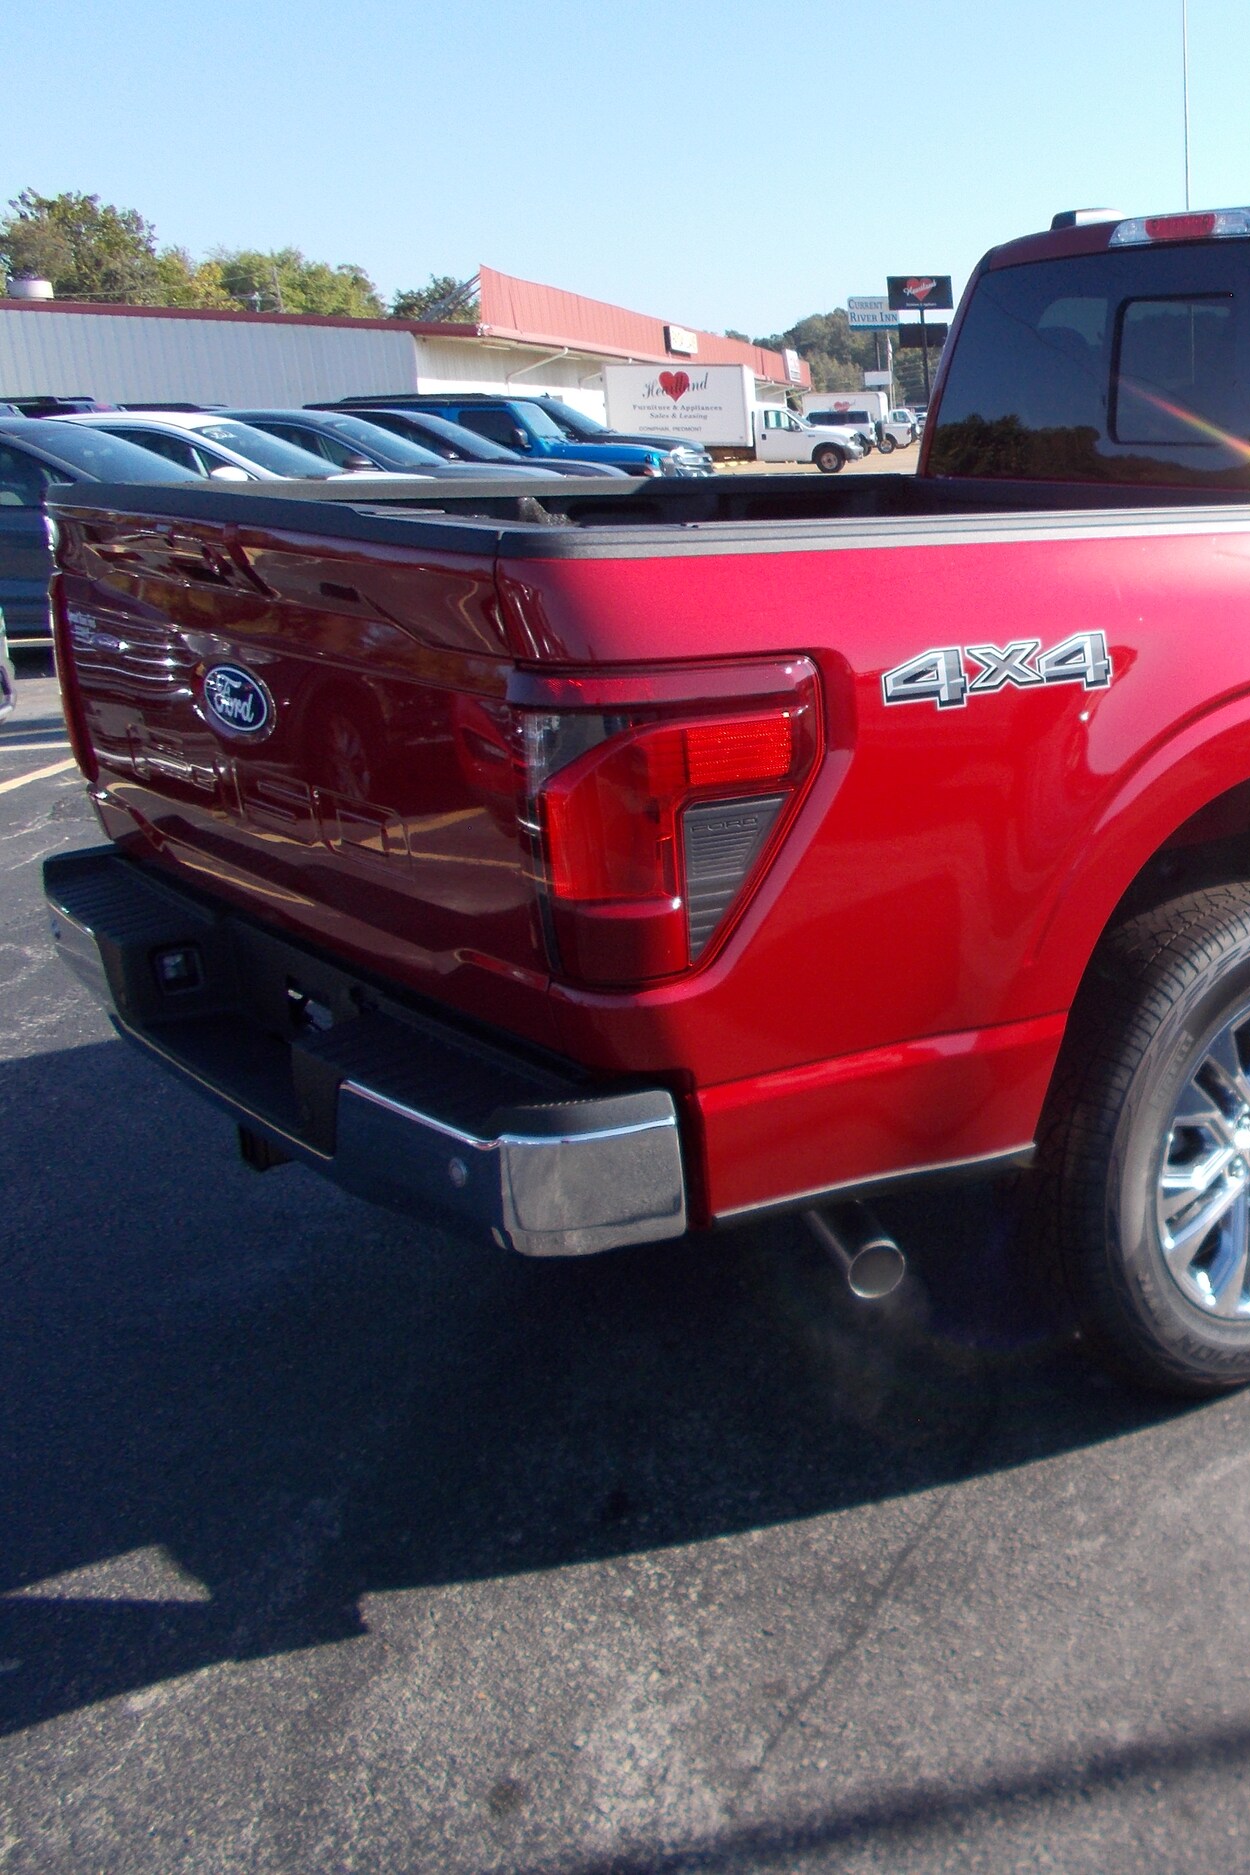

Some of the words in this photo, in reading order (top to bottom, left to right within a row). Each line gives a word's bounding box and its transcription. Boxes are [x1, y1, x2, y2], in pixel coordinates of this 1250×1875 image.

[848, 299, 883, 310] CURRENT
[850, 312, 878, 322] RIVER
[880, 312, 898, 322] INN
[680, 404, 723, 412] Appliances
[649, 412, 670, 420] Sales
[679, 412, 708, 420] Leasing
[213, 673, 254, 722] Ford
[691, 817, 758, 832] FORD
